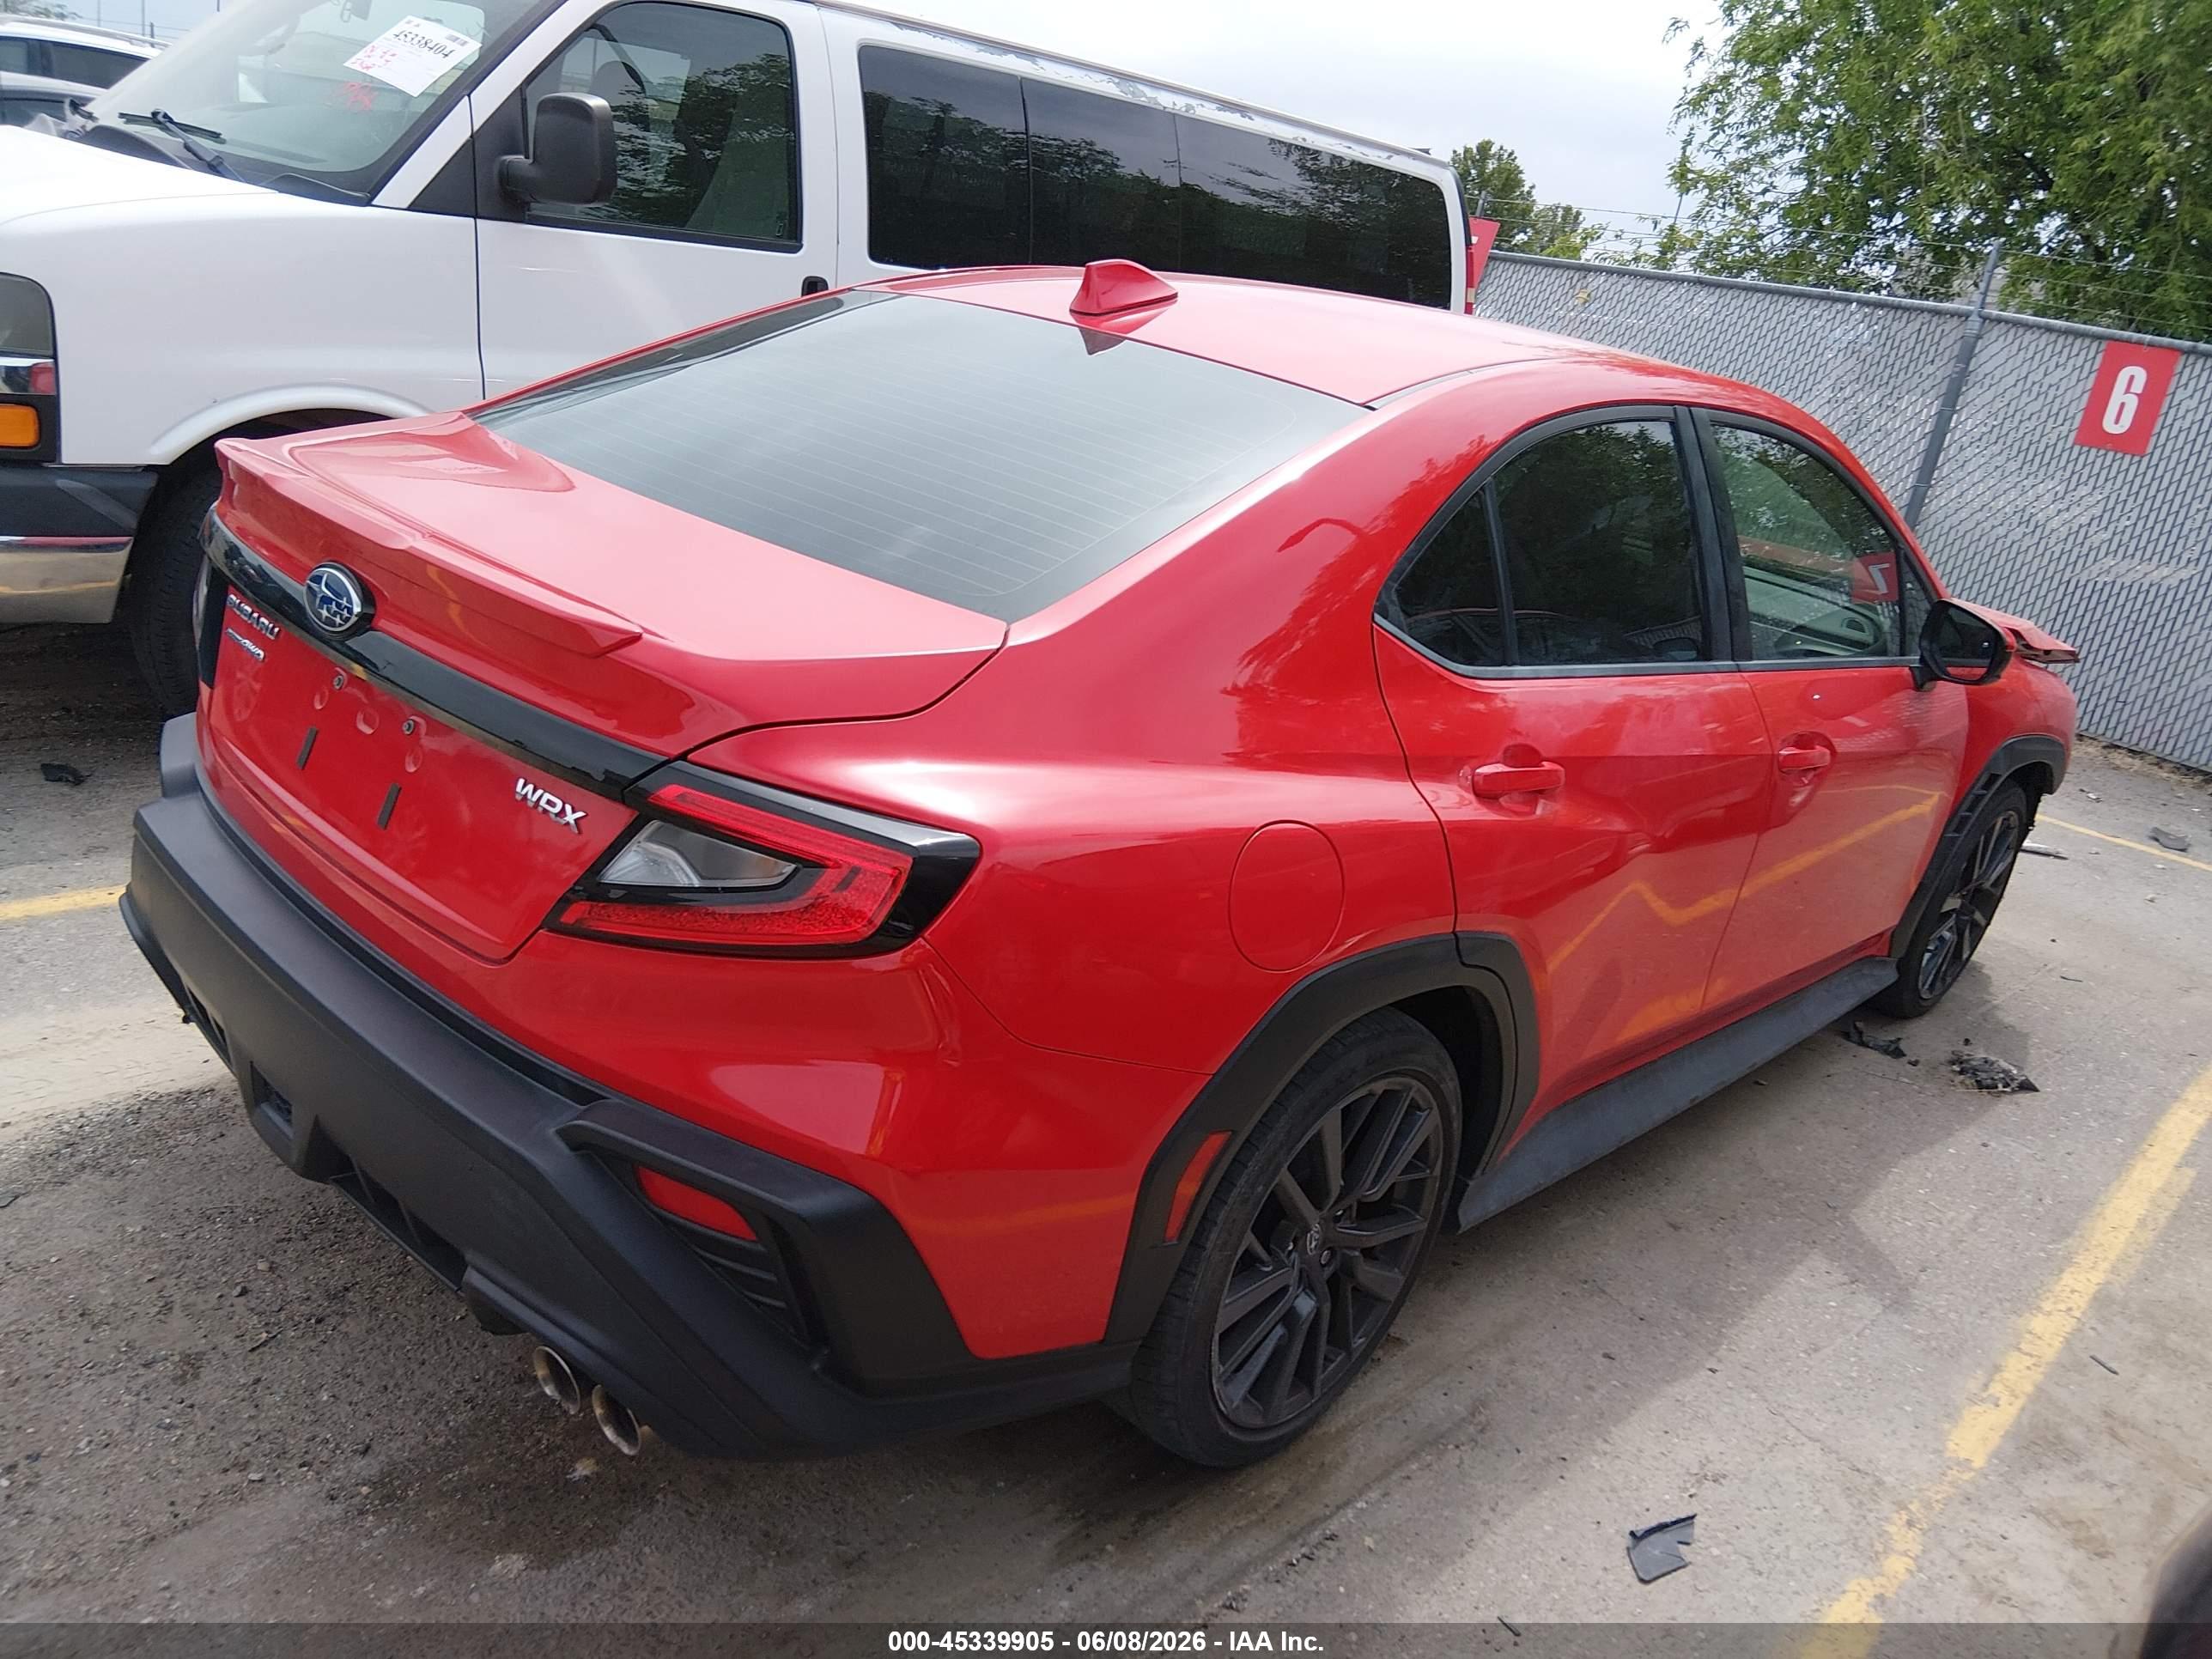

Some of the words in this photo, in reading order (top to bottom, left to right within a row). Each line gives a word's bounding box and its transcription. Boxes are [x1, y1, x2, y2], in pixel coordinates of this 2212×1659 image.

[392, 30, 456, 58] 45338404
[2102, 366, 2148, 434] 6
[226, 594, 280, 640] SUBARU
[515, 777, 587, 834] WRX
